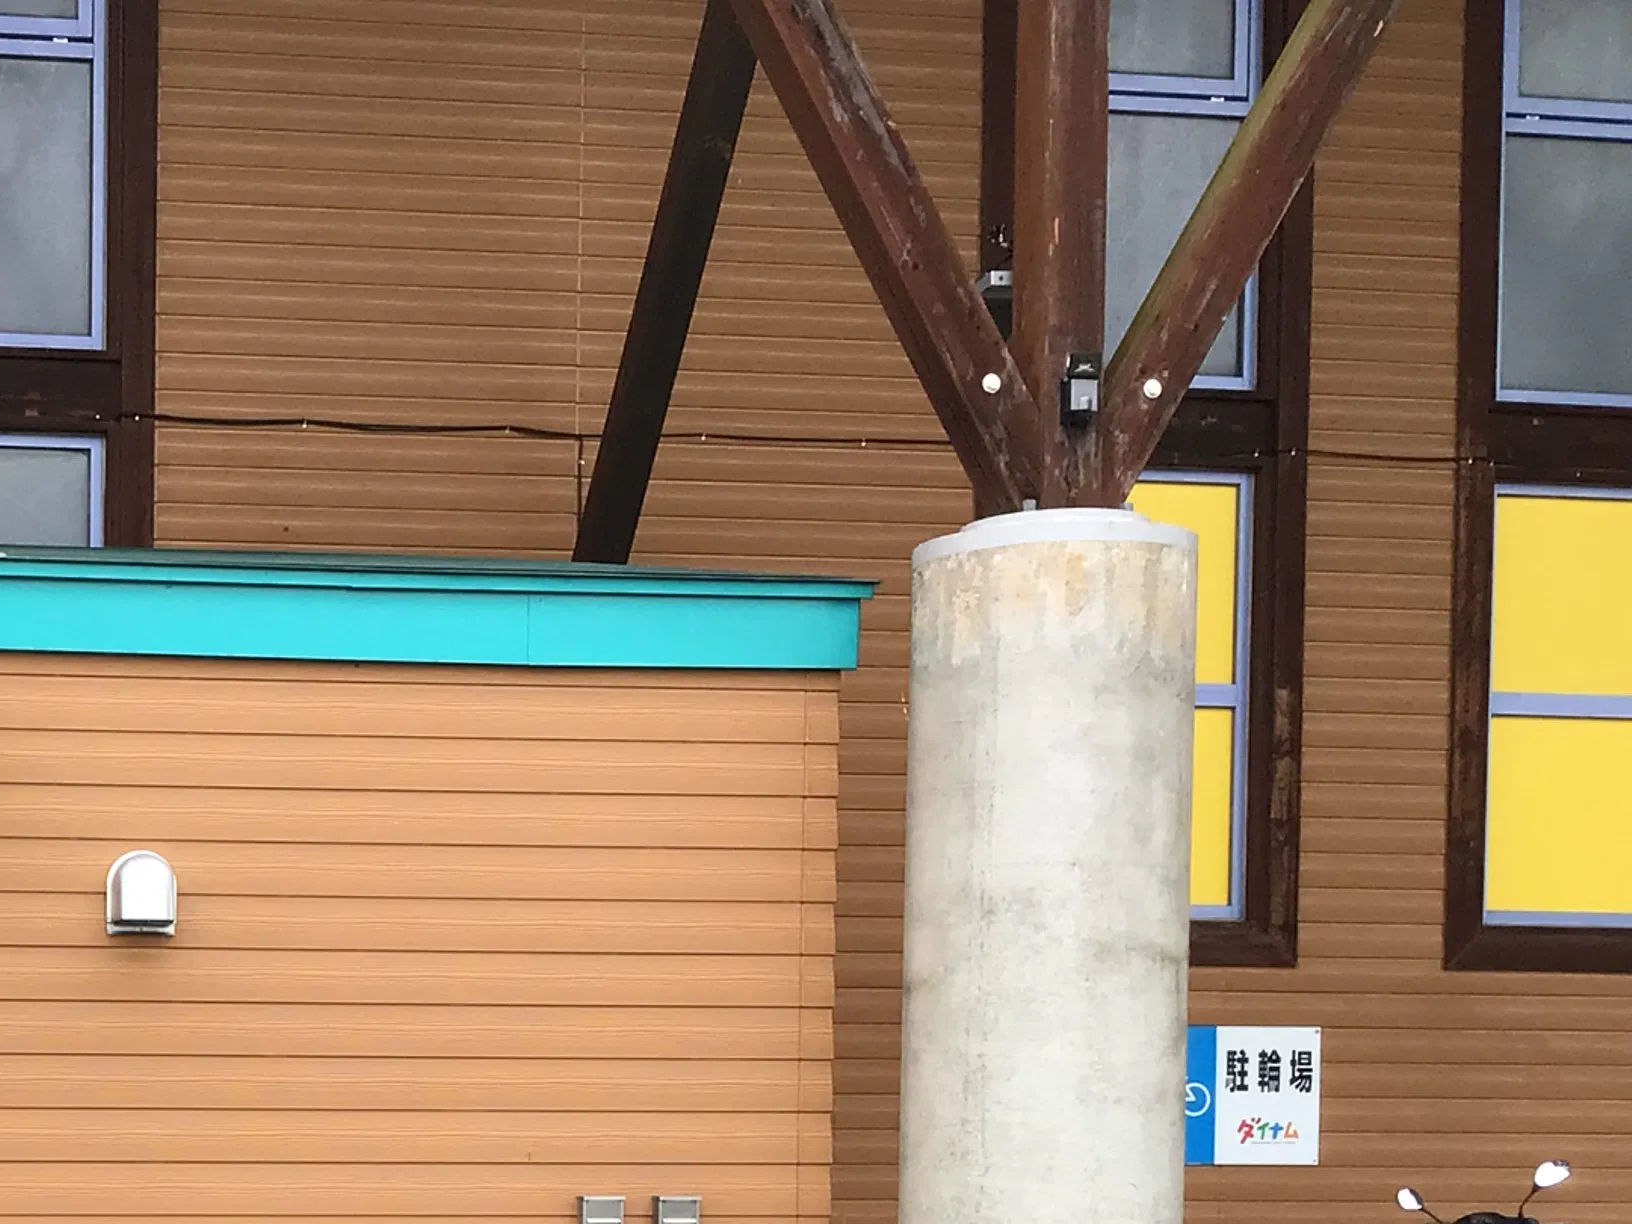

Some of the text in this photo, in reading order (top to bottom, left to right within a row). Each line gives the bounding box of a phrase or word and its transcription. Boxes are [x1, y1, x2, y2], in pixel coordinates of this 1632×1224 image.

[1225, 1049, 1313, 1093] 駐輪場
[1237, 1117, 1299, 1145] ダイナム
